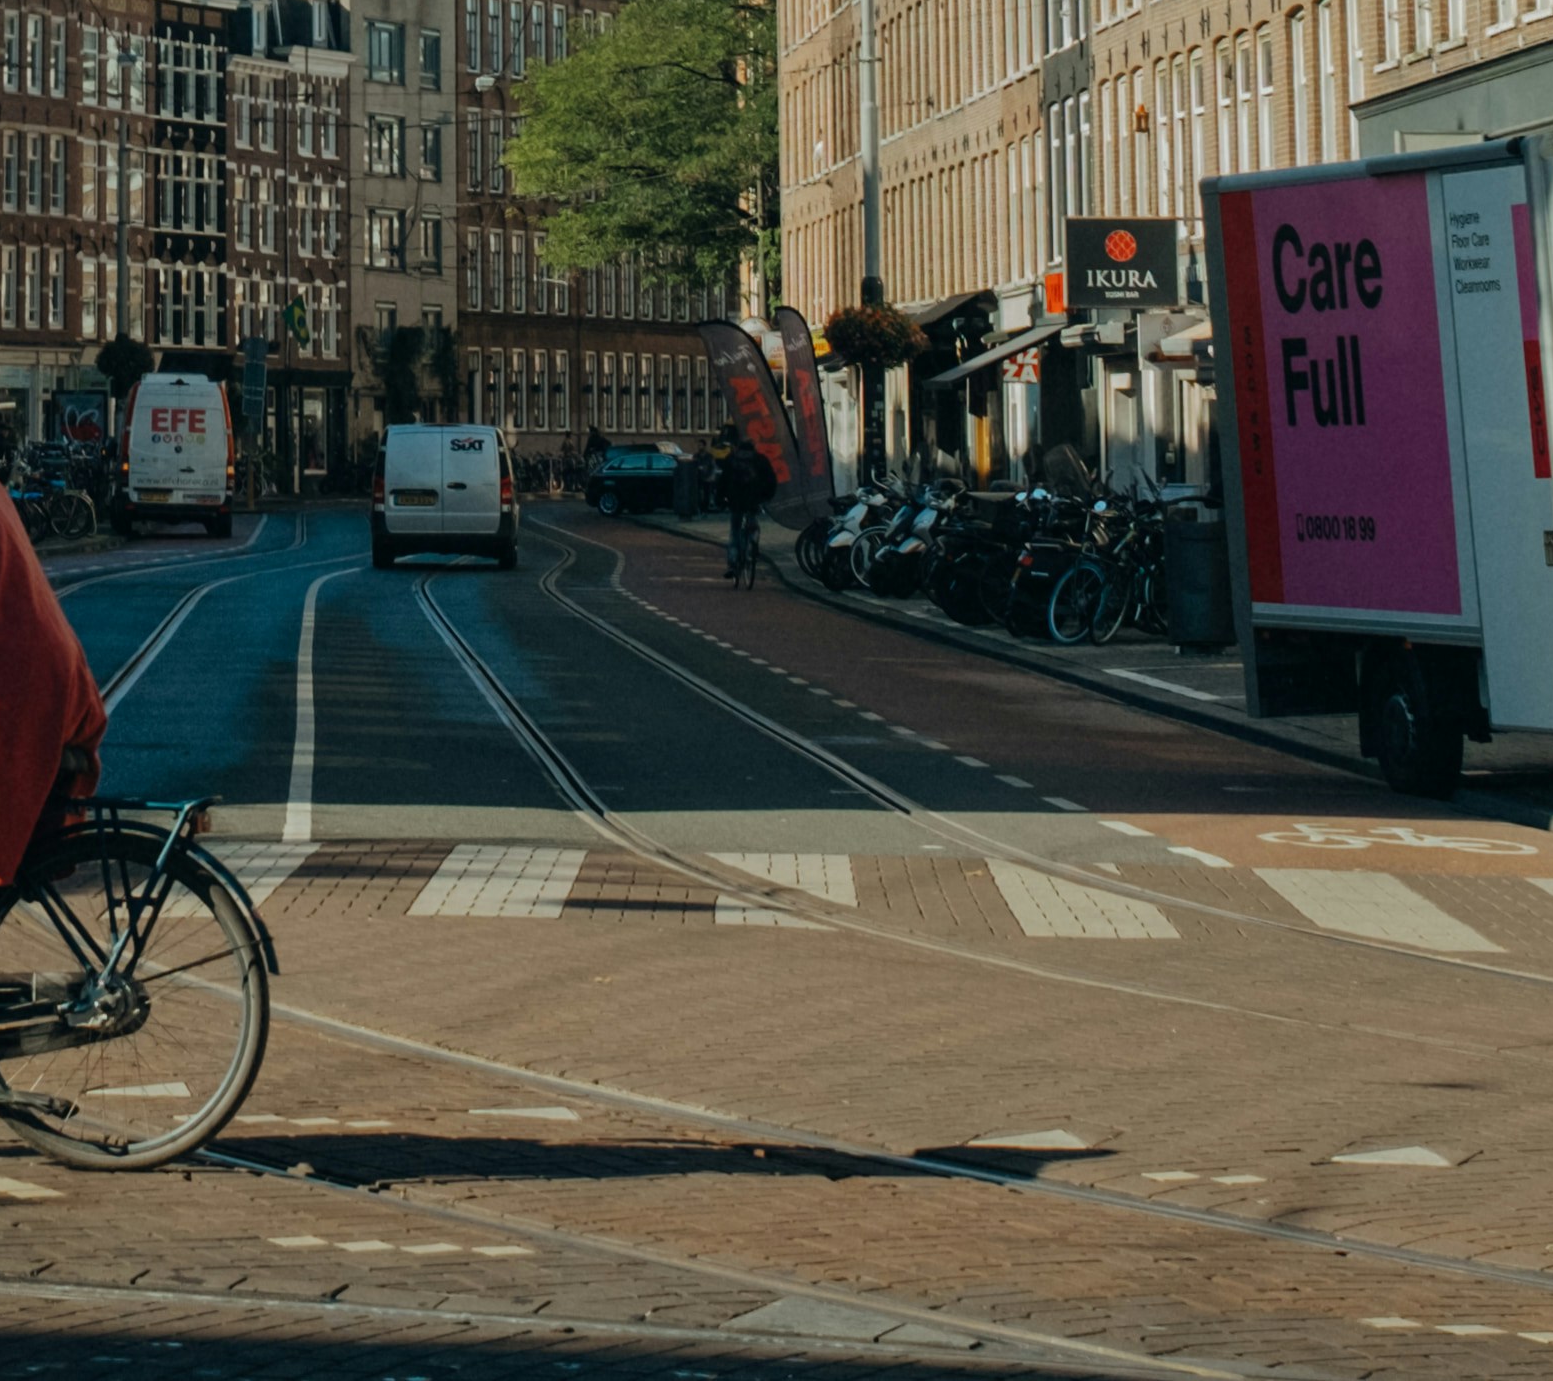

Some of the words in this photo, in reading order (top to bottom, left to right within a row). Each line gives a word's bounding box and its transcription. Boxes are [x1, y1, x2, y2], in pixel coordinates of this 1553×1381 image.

[1471, 232, 1490, 247] Care
[1086, 269, 1158, 288] IKURA
[1272, 223, 1383, 314] Care
[1280, 335, 1366, 427] Full
[151, 408, 206, 433] EFE
[450, 437, 485, 452] SIXT
[1306, 516, 1340, 540] 0800
[1342, 516, 1357, 541] 18
[1359, 516, 1376, 541] 99
